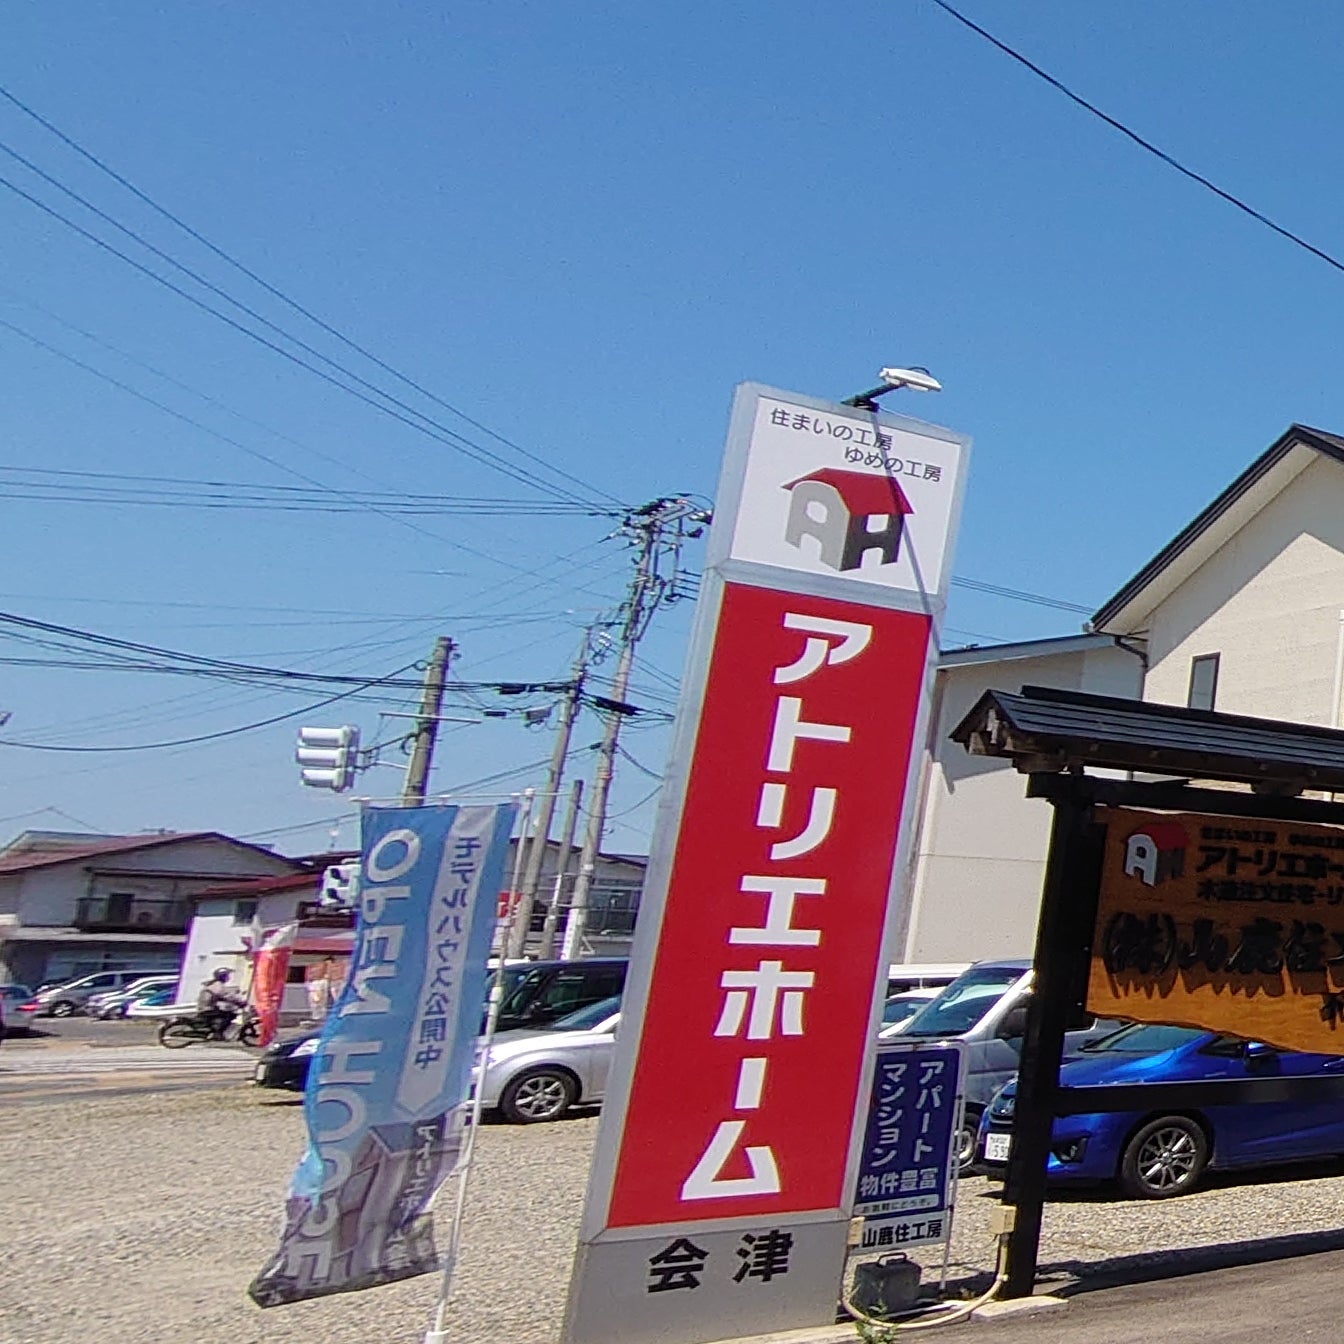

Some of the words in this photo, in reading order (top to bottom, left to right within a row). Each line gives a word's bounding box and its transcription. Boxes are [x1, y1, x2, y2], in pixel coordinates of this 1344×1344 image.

[771, 407, 893, 451] 住まいの工房
[844, 446, 942, 483] ゆめの工房
[680, 611, 873, 1201] アトリエホーム
[870, 1063, 908, 1168] マンション
[913, 1060, 945, 1163] アパート
[860, 1167, 939, 1197] 物件豊富
[646, 1228, 794, 1294] 会津
[861, 1218, 944, 1249] 山鹿住工房
